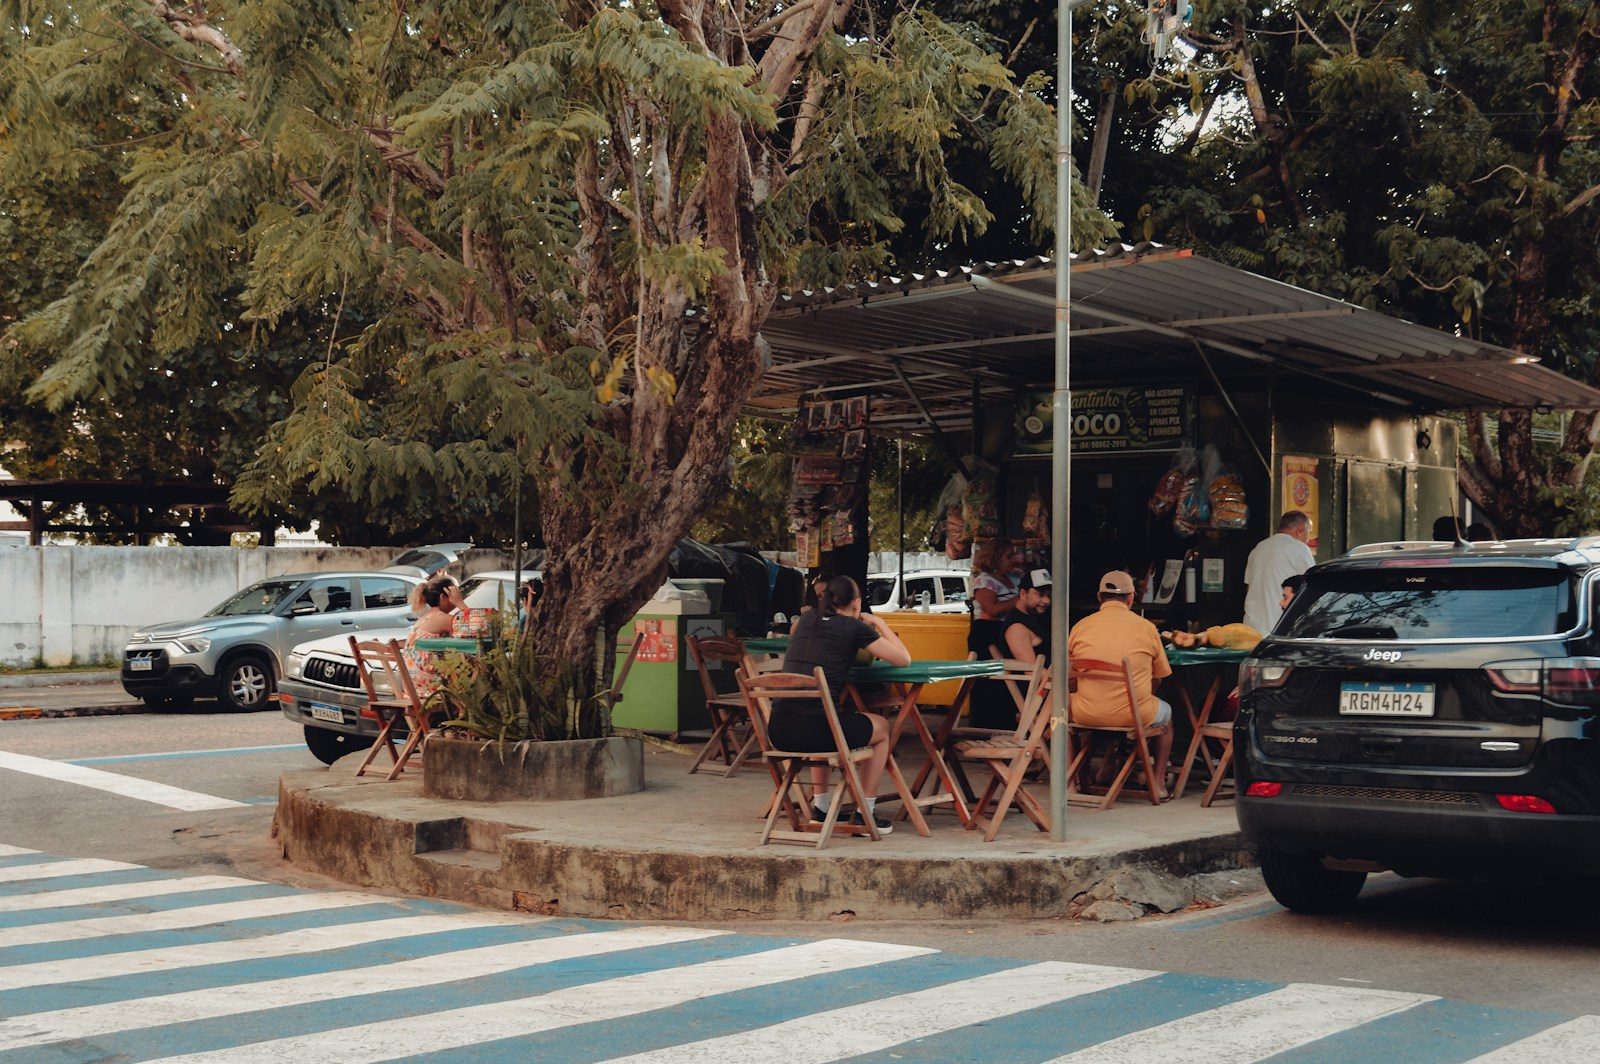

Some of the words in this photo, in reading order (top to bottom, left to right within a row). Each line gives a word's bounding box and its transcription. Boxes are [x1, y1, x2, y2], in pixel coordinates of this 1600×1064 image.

[1070, 389, 1120, 409] antinho
[1148, 398, 1180, 406] PAGAMENTOS
[1158, 407, 1178, 415] CARTÃO
[1070, 414, 1121, 436] OCO
[1169, 416, 1180, 424] PIX
[1153, 426, 1182, 435] DINHEIRO
[1363, 648, 1402, 663] Jeep
[1349, 693, 1423, 711] RGM4H24
